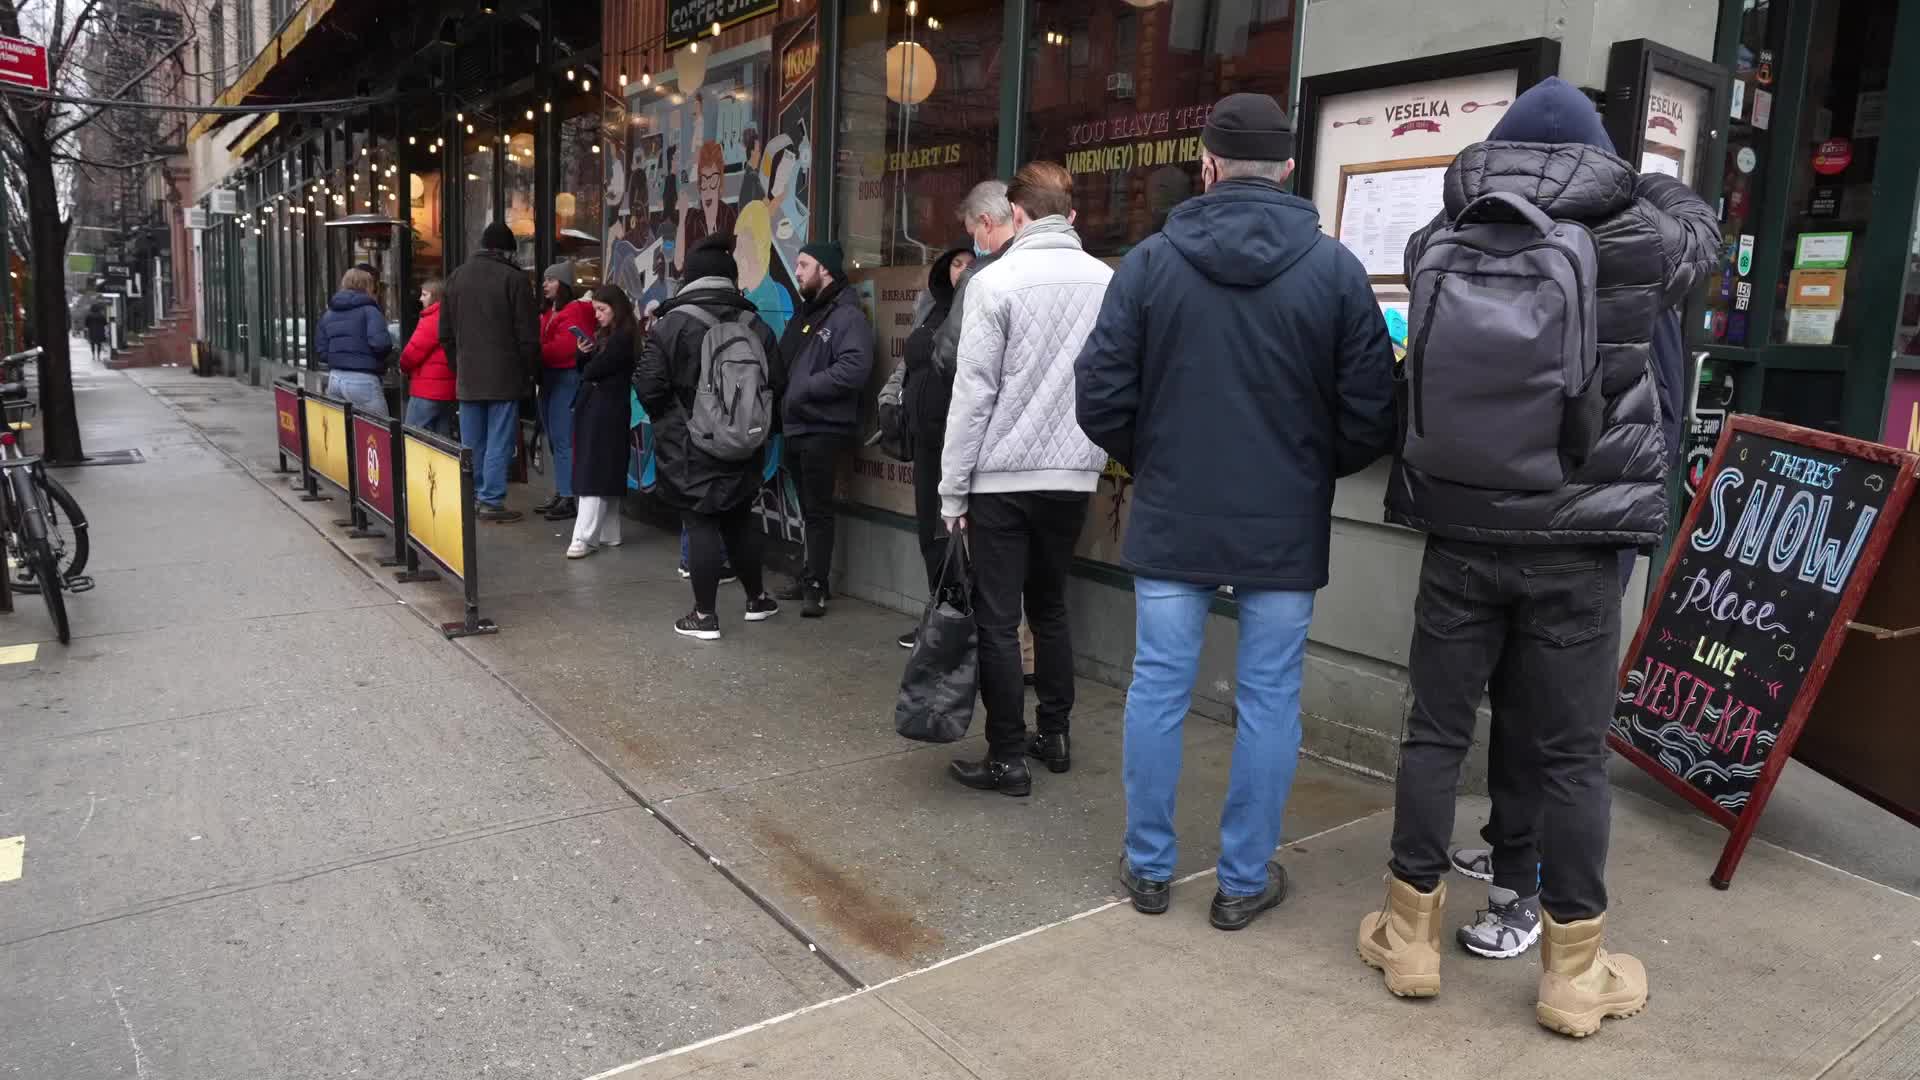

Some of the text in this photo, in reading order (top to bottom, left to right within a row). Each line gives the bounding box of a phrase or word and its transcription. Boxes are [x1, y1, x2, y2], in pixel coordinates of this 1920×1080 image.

[1070, 121, 1107, 146] YOU
[1109, 111, 1170, 140] HAVE
[1385, 100, 1449, 123] VESELKA
[889, 146, 942, 171] HEART
[944, 143, 961, 163] IS
[1066, 136, 1204, 175] VAREN(KEY) TO MY HEA
[881, 288, 921, 302] BREAKF
[1703, 419, 1720, 434] SHIP
[367, 447, 380, 487] 60
[887, 464, 896, 481] IS
[898, 464, 914, 485] VES
[1769, 450, 1841, 489] THERE'S
[1691, 467, 1878, 594] SNOW
[1676, 567, 1791, 634] place
[1693, 635, 1747, 678] LIKE
[1633, 656, 1762, 765] VESELKA
